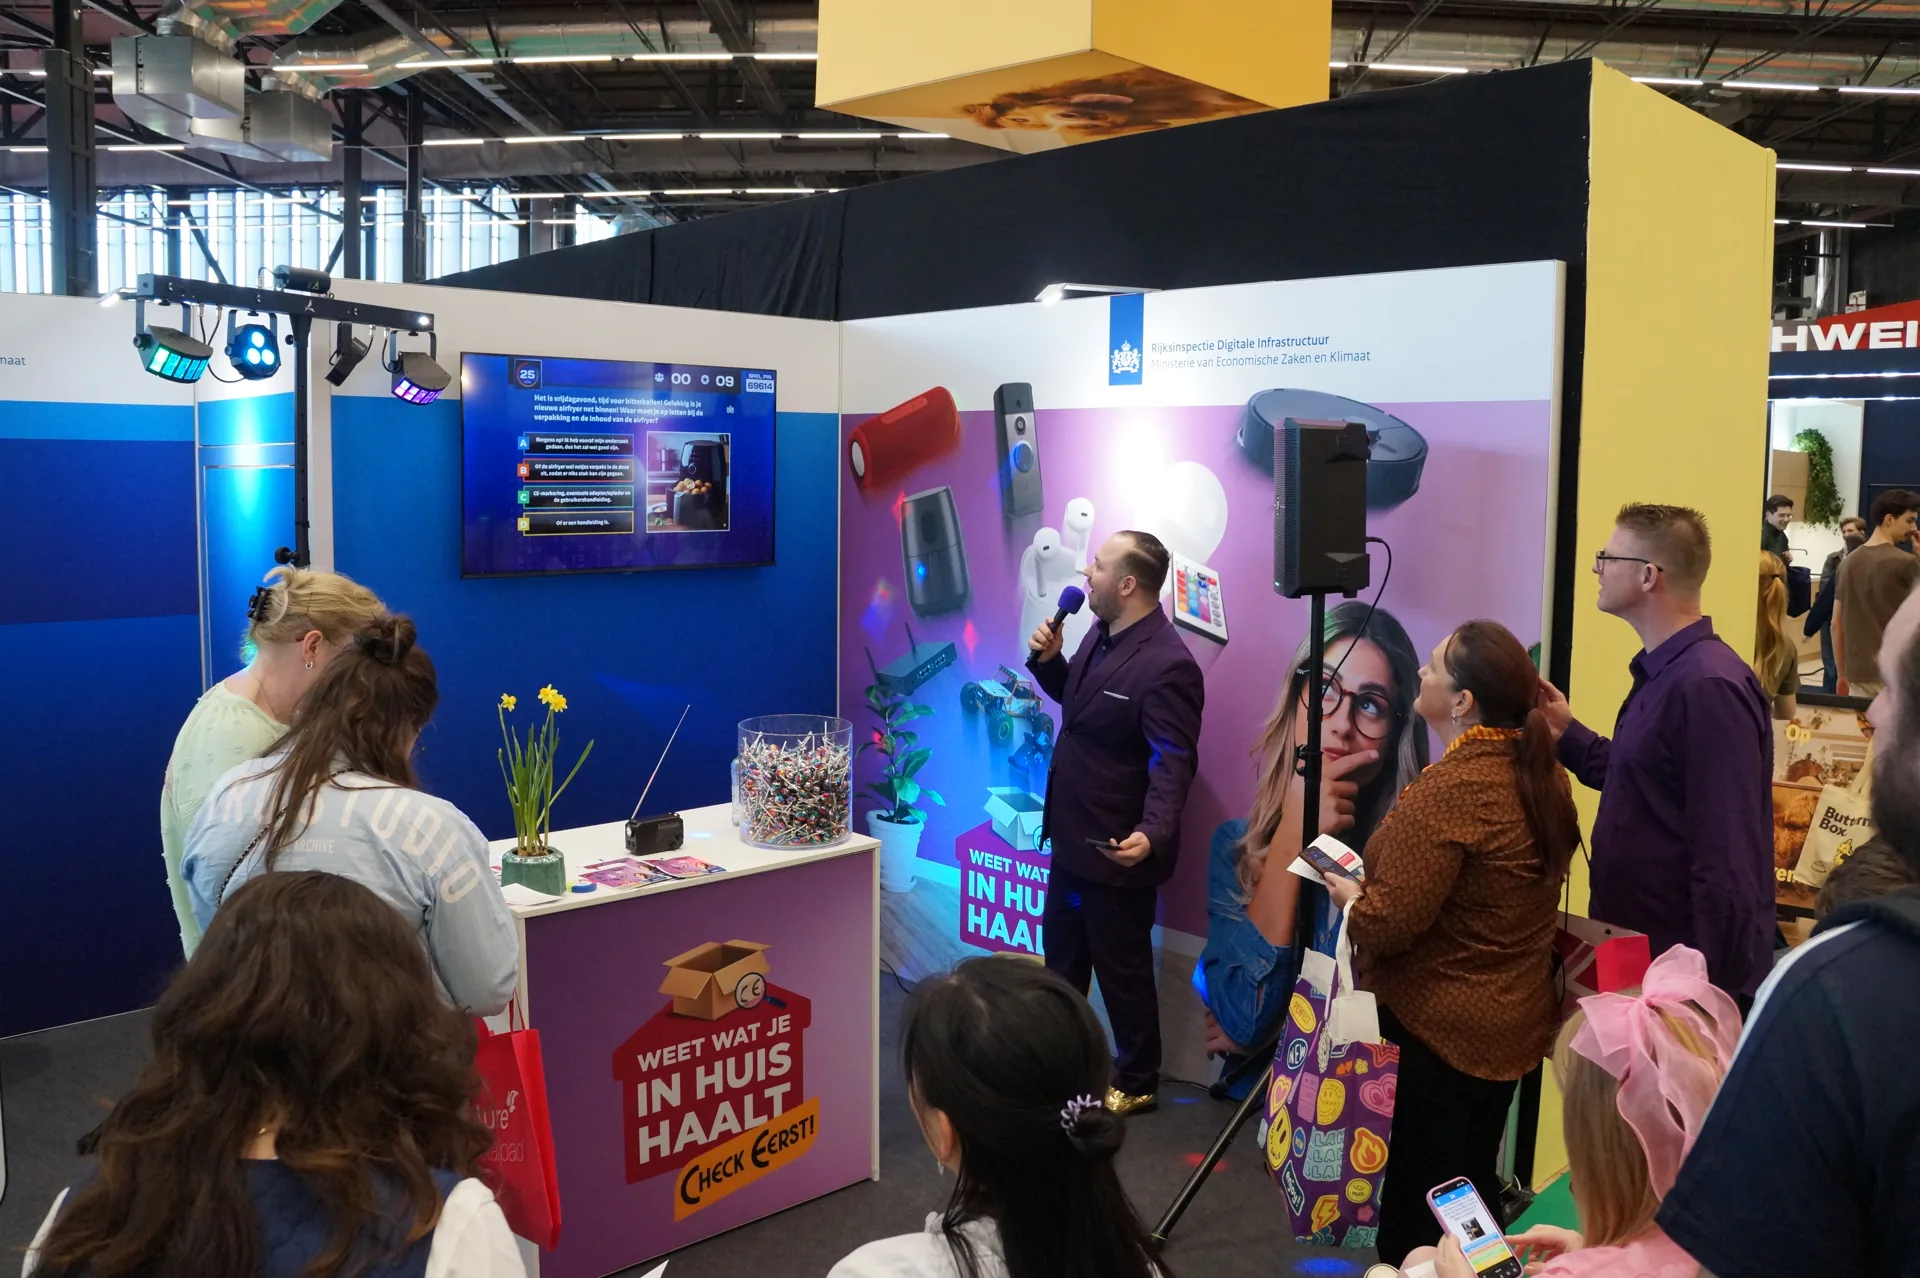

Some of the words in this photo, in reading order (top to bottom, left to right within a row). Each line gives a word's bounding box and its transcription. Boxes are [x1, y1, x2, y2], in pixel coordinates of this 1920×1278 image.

[1151, 340, 1215, 355] Rijksinspectie
[1217, 338, 1255, 352] Digitale
[1257, 336, 1330, 348] Infrastructuur
[1151, 358, 1195, 369] Ministerie
[1197, 359, 1214, 368] van
[1216, 354, 1279, 367] Economische
[1281, 353, 1312, 365] Zaken
[1314, 354, 1327, 363] en
[1330, 350, 1371, 362] Klimaat
[519, 369, 536, 380] 25
[670, 373, 692, 385] 00
[715, 375, 735, 387] 09
[747, 381, 773, 391] 69614
[534, 394, 547, 402] Het
[547, 394, 553, 402] is
[554, 395, 598, 404] vrijdagavond,
[598, 397, 609, 405] tijd
[625, 398, 663, 406] bitterballen!
[663, 399, 689, 408] Gelukkig
[559, 404, 583, 413] airfryer
[653, 408, 660, 416] je
[669, 408, 686, 416] letten
[687, 409, 695, 417] bij
[695, 409, 703, 417] de
[534, 414, 571, 422] verpakking
[580, 414, 588, 422] de
[633, 416, 658, 425] airfryer?
[520, 439, 527, 447] A
[520, 466, 527, 475] B
[520, 493, 527, 502] C
[520, 520, 527, 529] D
[1819, 817, 1847, 837] Box
[292, 838, 336, 854] ARCHIVE
[968, 848, 1012, 875] WEET
[1015, 860, 1050, 885] WAT
[968, 870, 996, 904] IN
[1004, 882, 1045, 917] HU
[637, 1038, 705, 1072] WEET
[711, 1022, 760, 1052] WAT
[766, 1014, 791, 1037] JE
[1288, 1043, 1306, 1065] NEW
[637, 1072, 681, 1118] IN
[696, 1042, 792, 1100] HUIS
[638, 1082, 791, 1165] HAALT
[680, 1150, 744, 1205] CHECK
[751, 1114, 815, 1168] EERST!
[1286, 1171, 1302, 1207] enjoy!
